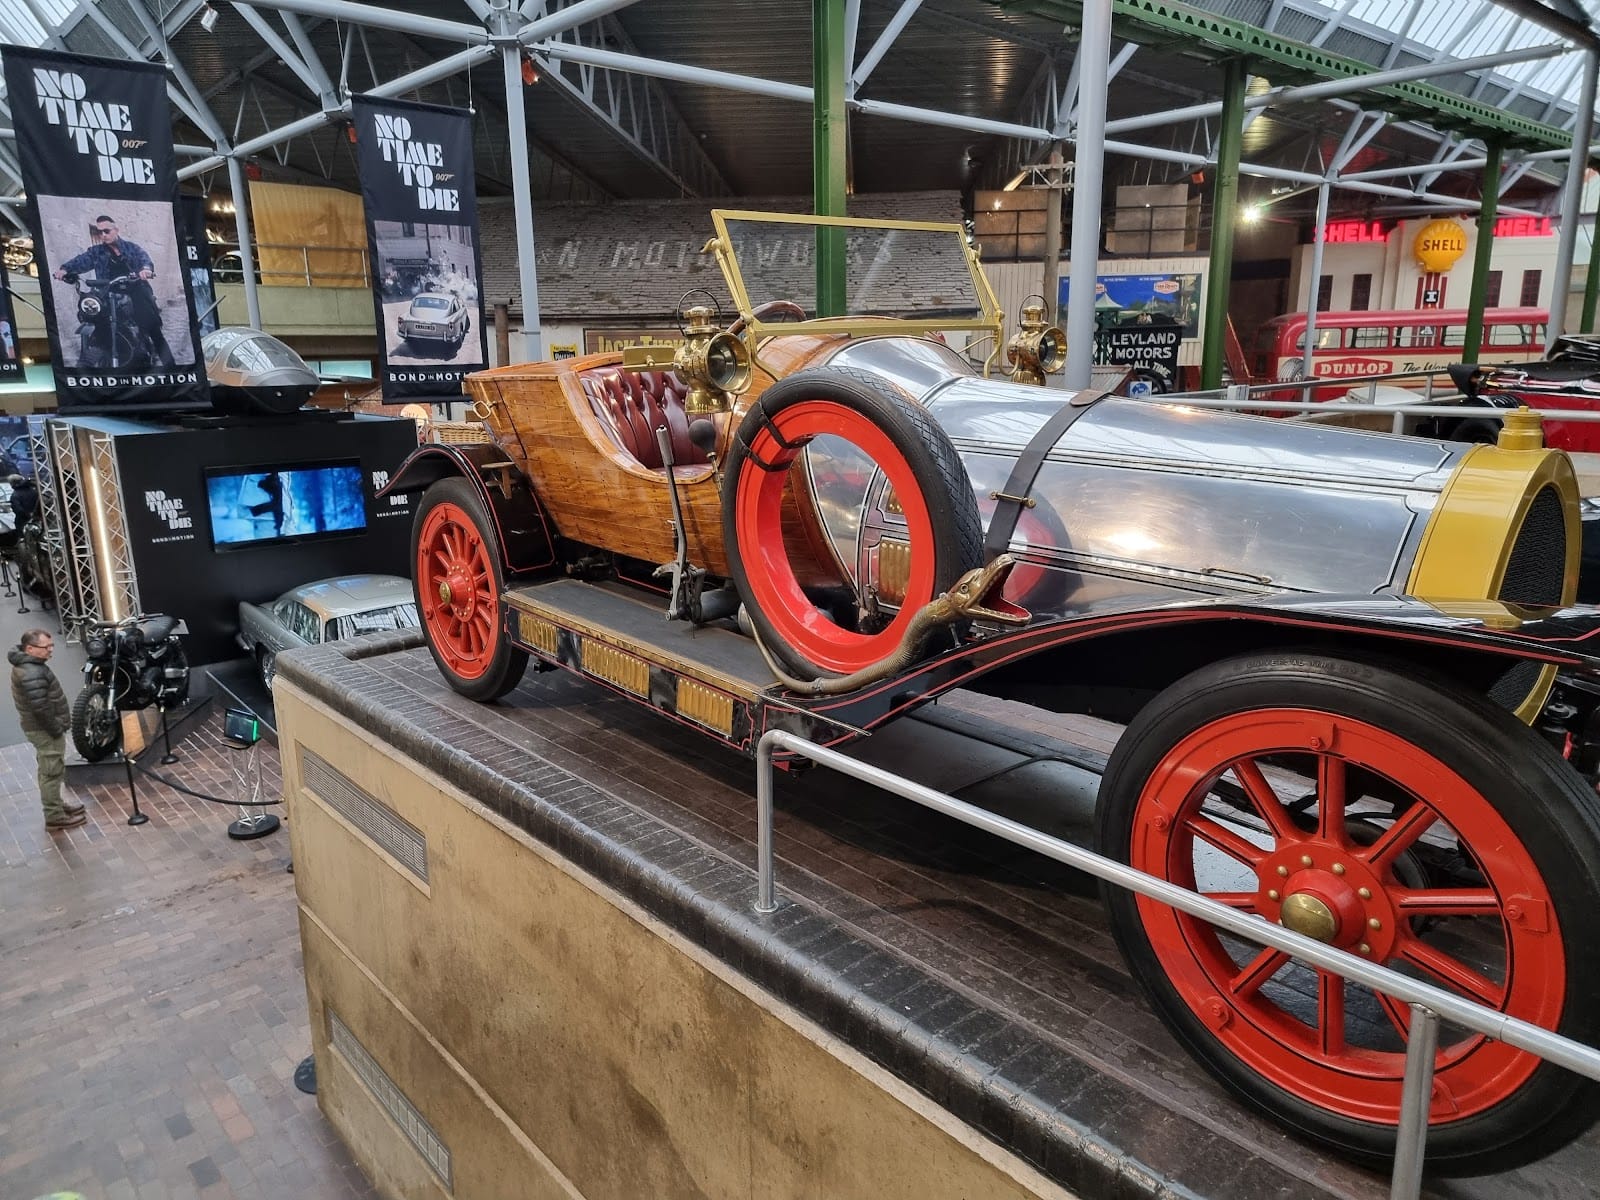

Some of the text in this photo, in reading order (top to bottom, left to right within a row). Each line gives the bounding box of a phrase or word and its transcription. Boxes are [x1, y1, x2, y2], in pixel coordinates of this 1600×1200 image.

[33, 67, 87, 101] NO
[37, 95, 133, 132] TIME
[374, 113, 412, 141] NO
[67, 126, 120, 155] TO
[121, 139, 147, 149] 007
[377, 136, 444, 168] TIME
[97, 155, 156, 185] DIE
[397, 161, 434, 188] TO
[435, 173, 454, 182] 007
[417, 186, 460, 212] DIE
[1492, 217, 1554, 238] HELL
[1422, 239, 1463, 251] SHELL
[1112, 332, 1176, 346] LEYLAND
[1115, 346, 1172, 359] MOTORS
[389, 372, 426, 382] BOND
[1133, 360, 1172, 378] ALL TIME
[1320, 362, 1389, 375] DUNLOP
[1402, 362, 1422, 372] The
[67, 376, 118, 387] BOND
[131, 373, 198, 386] MOTION
